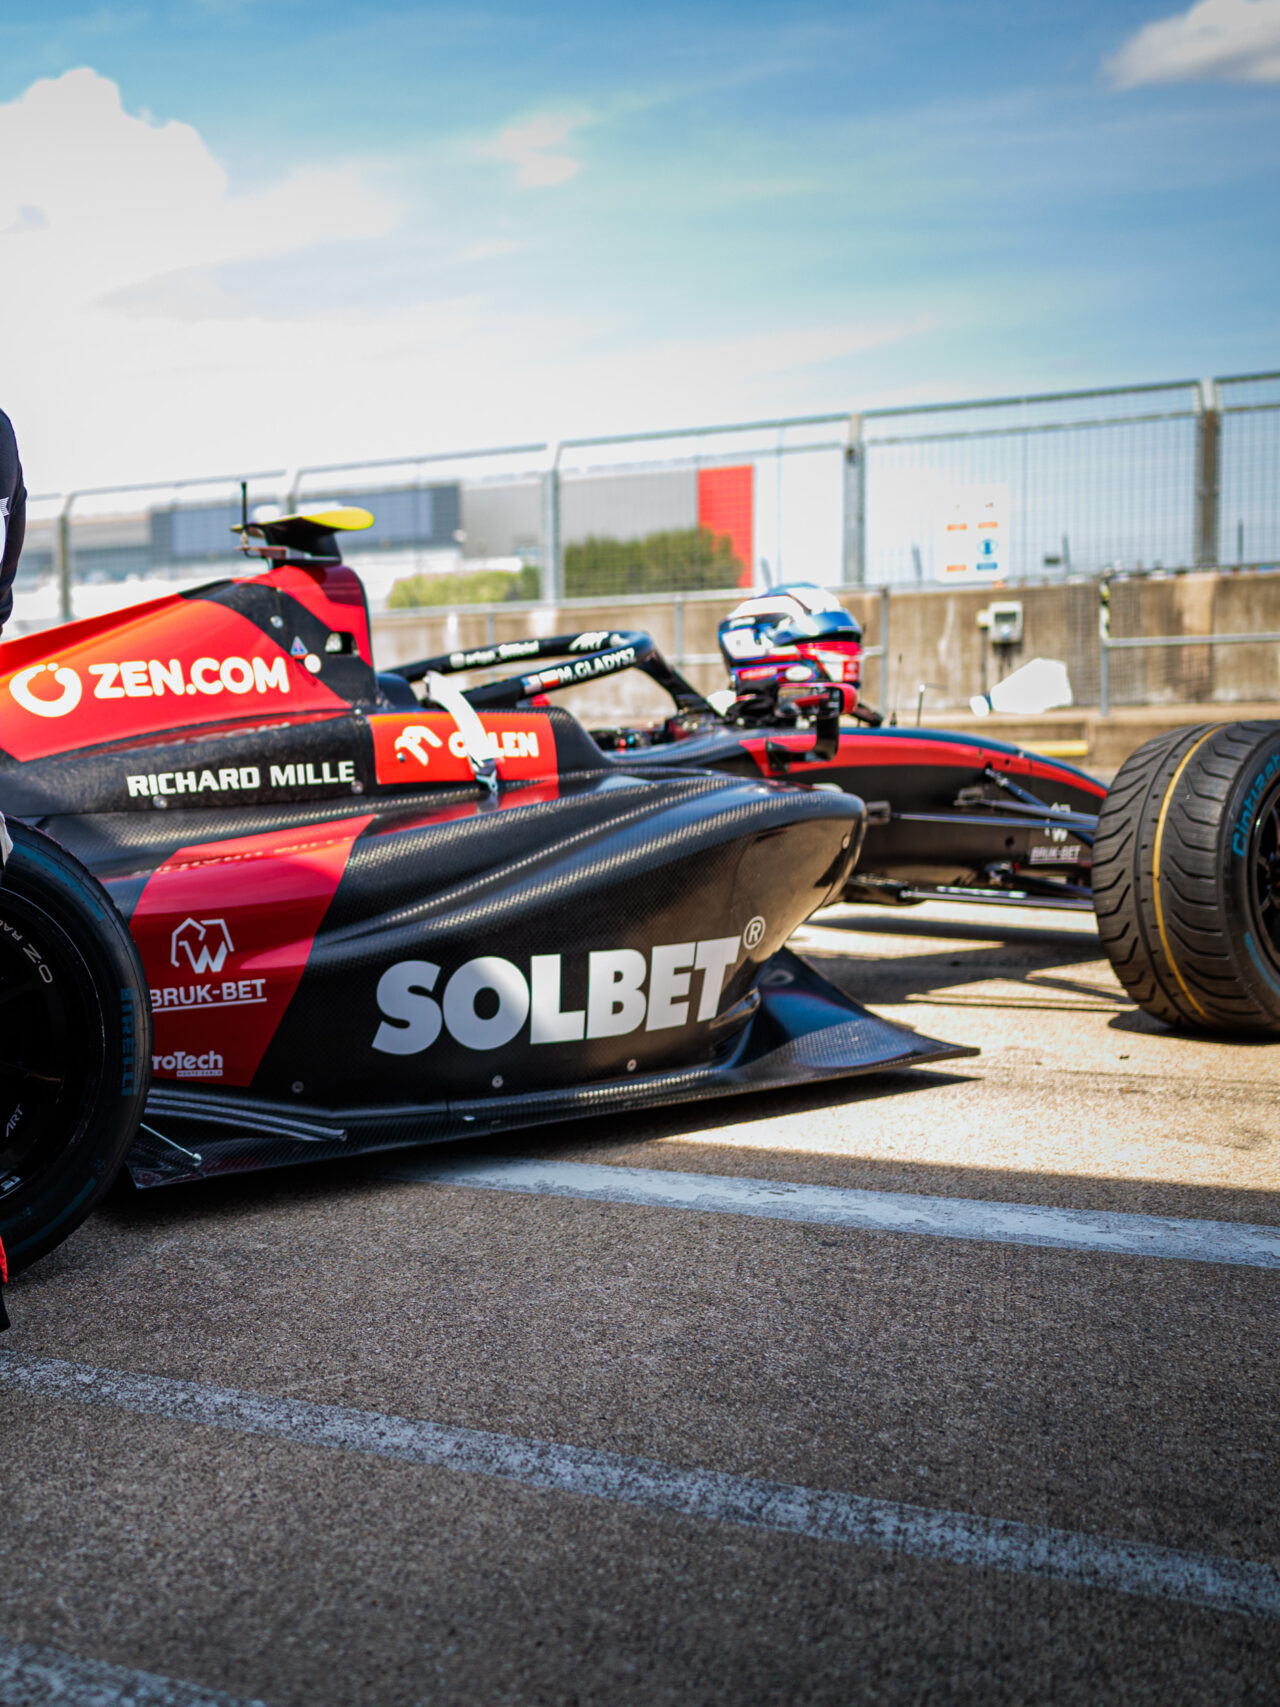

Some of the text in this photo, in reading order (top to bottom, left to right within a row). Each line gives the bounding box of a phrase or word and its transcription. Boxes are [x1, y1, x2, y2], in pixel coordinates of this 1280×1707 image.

[88, 656, 290, 699] ZEN.COM
[126, 760, 356, 798] RICHARD MILLE
[150, 978, 267, 1008] BRUK-BET
[151, 1050, 224, 1071] roTech
[5, 1103, 24, 1138] ART
